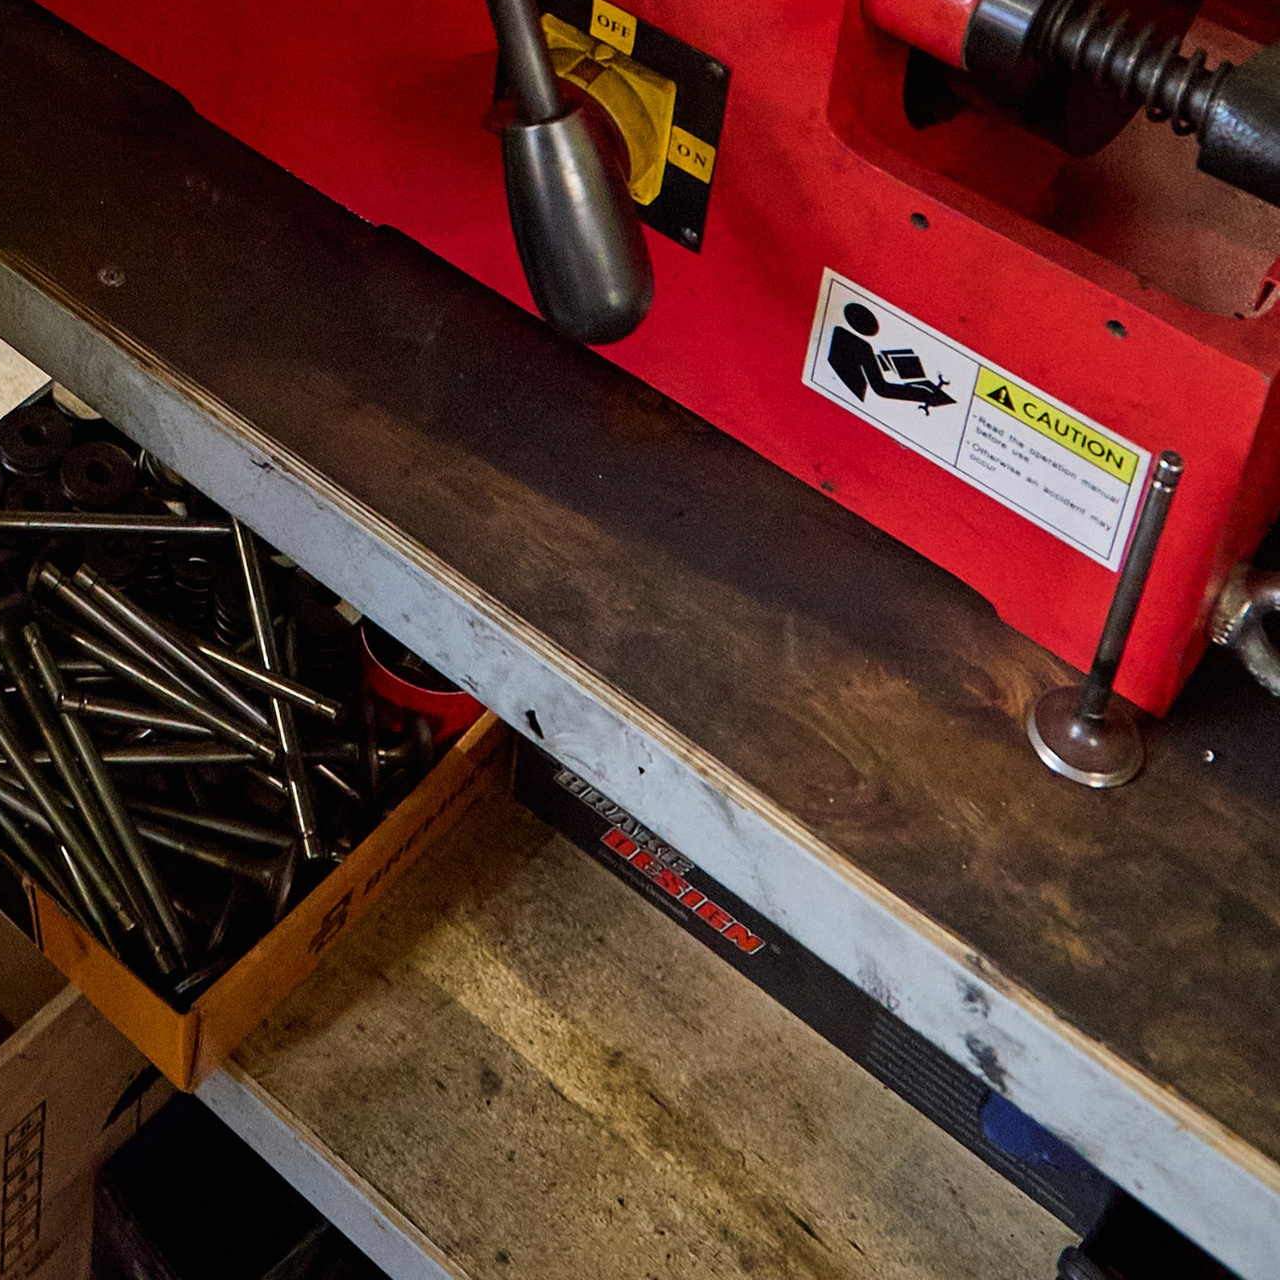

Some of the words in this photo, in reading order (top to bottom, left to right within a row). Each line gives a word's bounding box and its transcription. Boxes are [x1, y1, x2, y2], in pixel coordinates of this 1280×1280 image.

[597, 12, 631, 40] OFF
[677, 142, 708, 169] ON
[976, 427, 1007, 450] before
[979, 416, 1005, 437] Read
[1009, 434, 1024, 449] the
[1030, 447, 1077, 480] operation
[1081, 478, 1119, 504] manual
[1023, 402, 1124, 470] CAUTION
[972, 443, 1021, 476] Otherwise
[1026, 476, 1039, 487] an
[1043, 488, 1086, 516] accident
[1090, 514, 1112, 532] may
[554, 766, 695, 876] BRAKE
